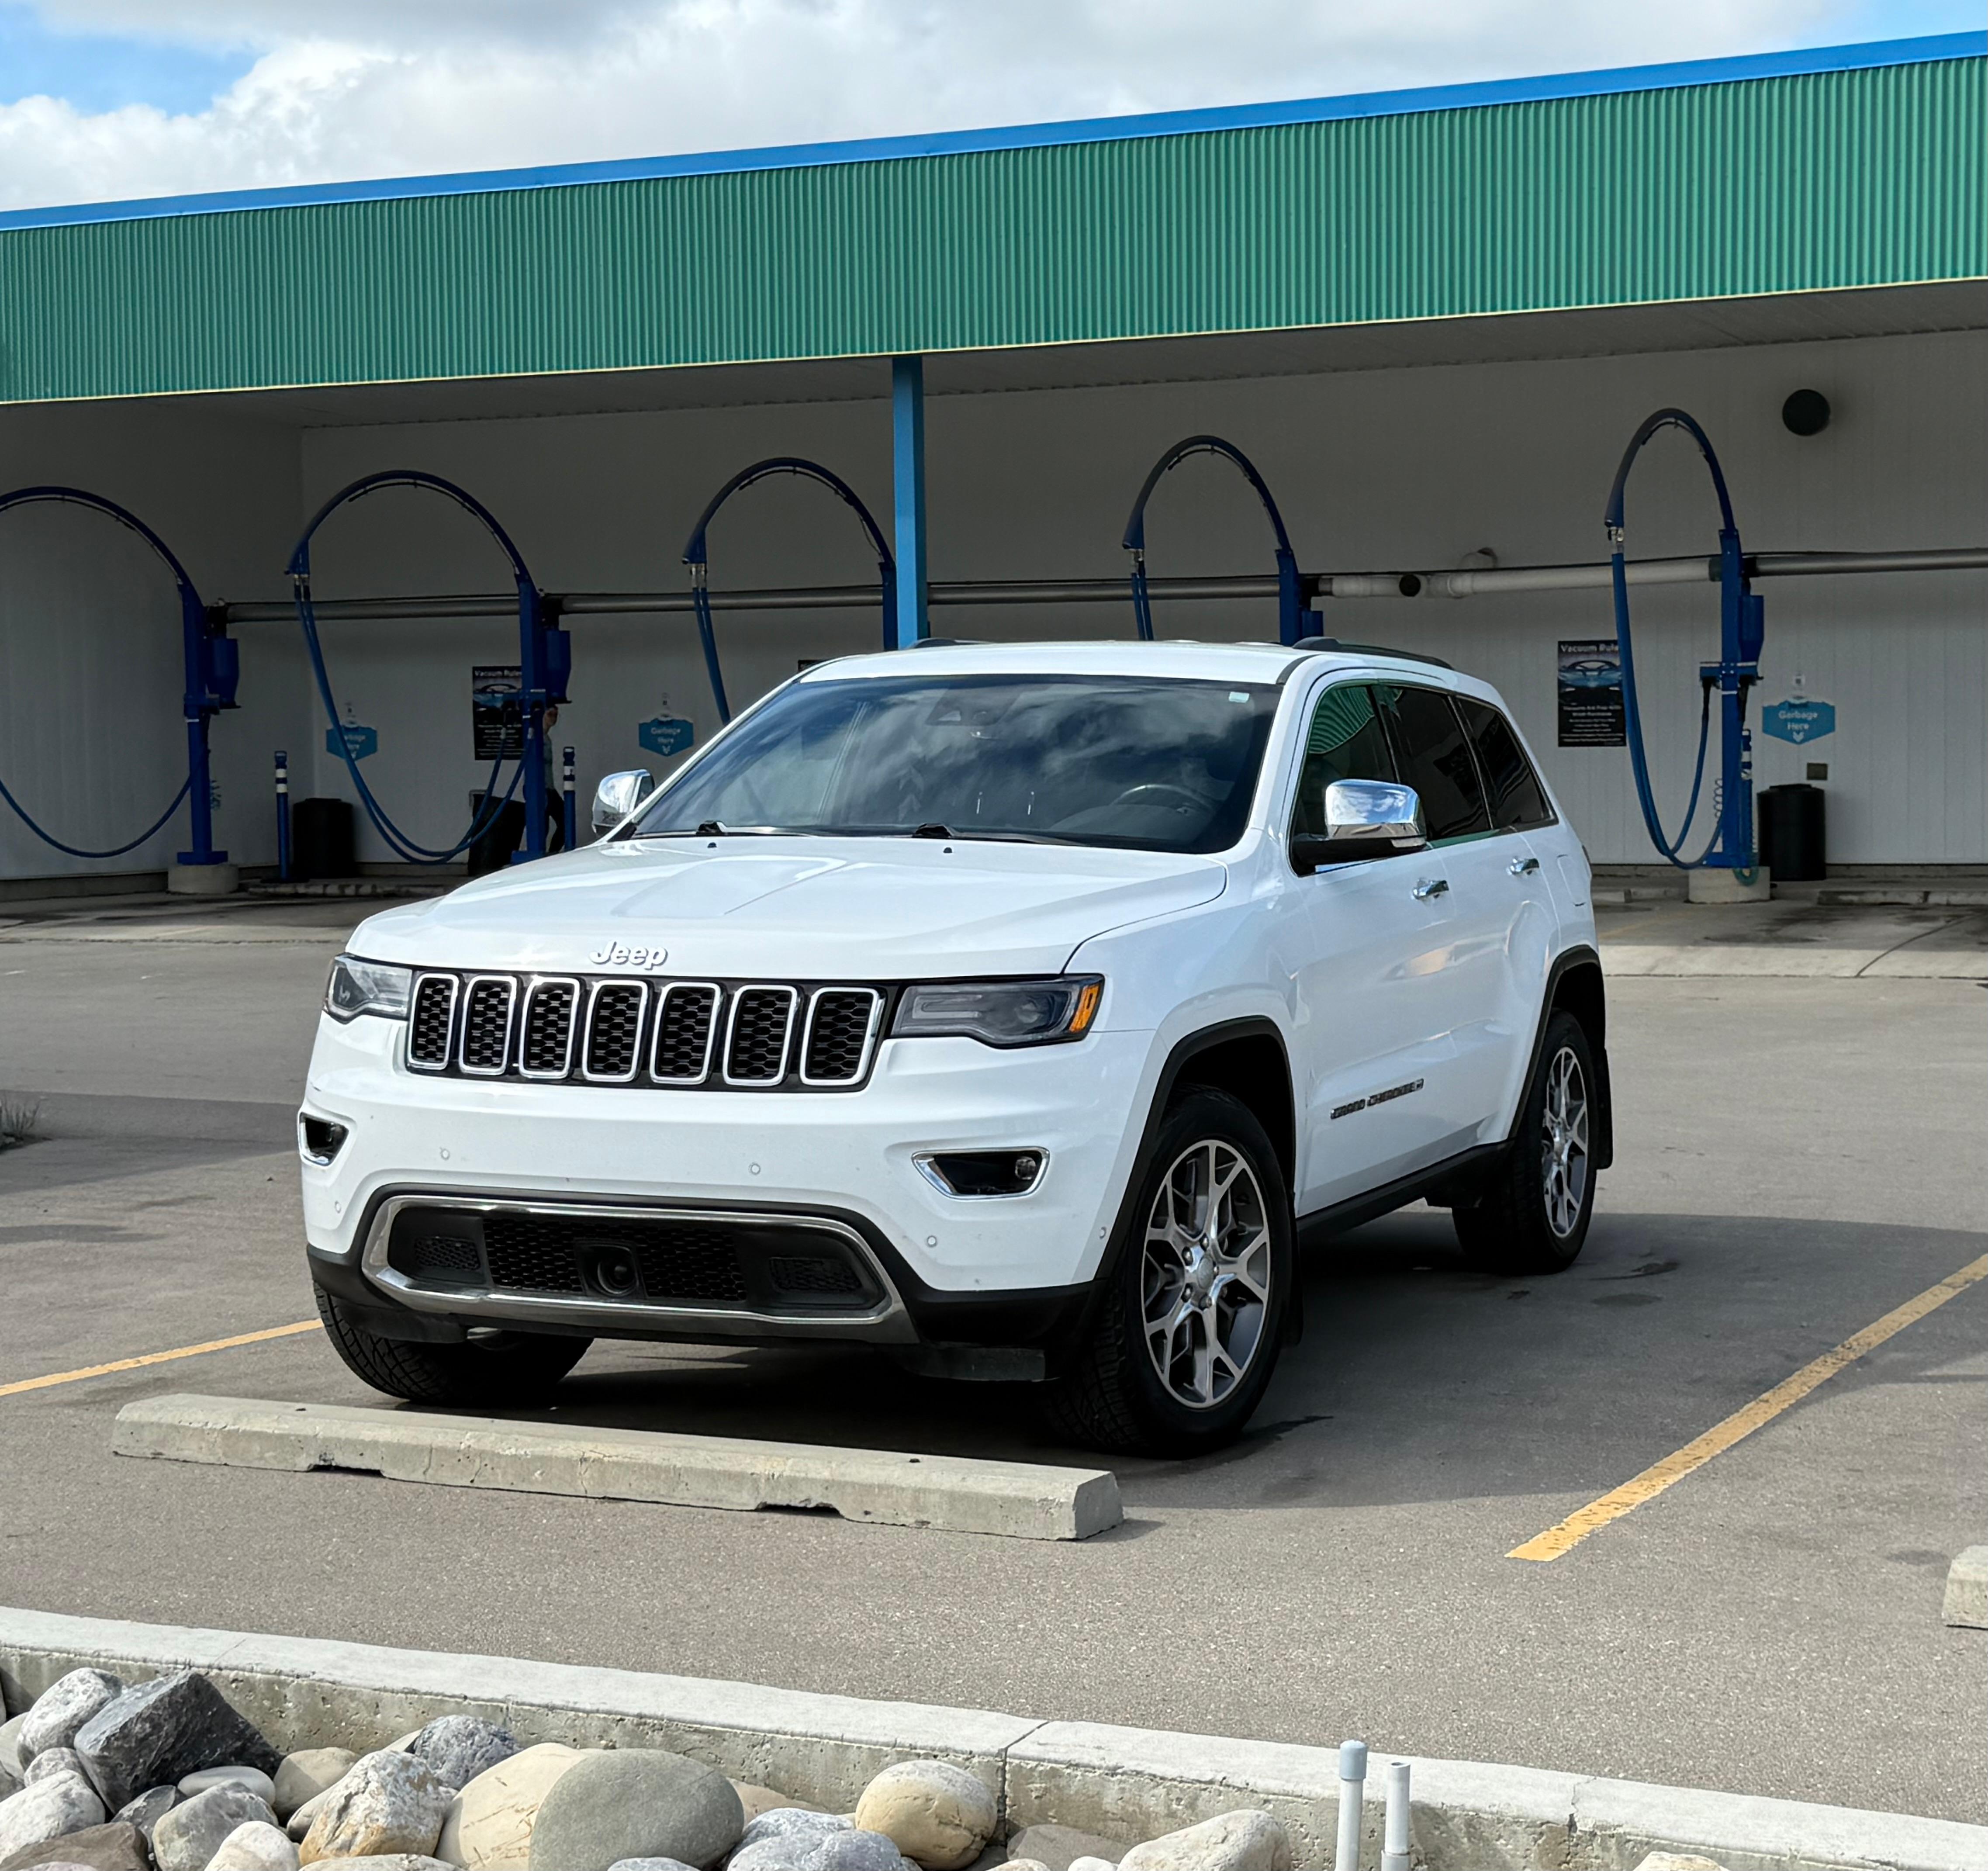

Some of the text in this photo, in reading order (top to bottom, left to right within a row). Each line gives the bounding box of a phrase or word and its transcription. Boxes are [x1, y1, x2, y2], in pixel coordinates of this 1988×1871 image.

[1778, 710, 1819, 721] Garbage
[1787, 721, 1810, 730] Here
[651, 726, 681, 736] Garbage
[589, 941, 668, 970] Jeep
